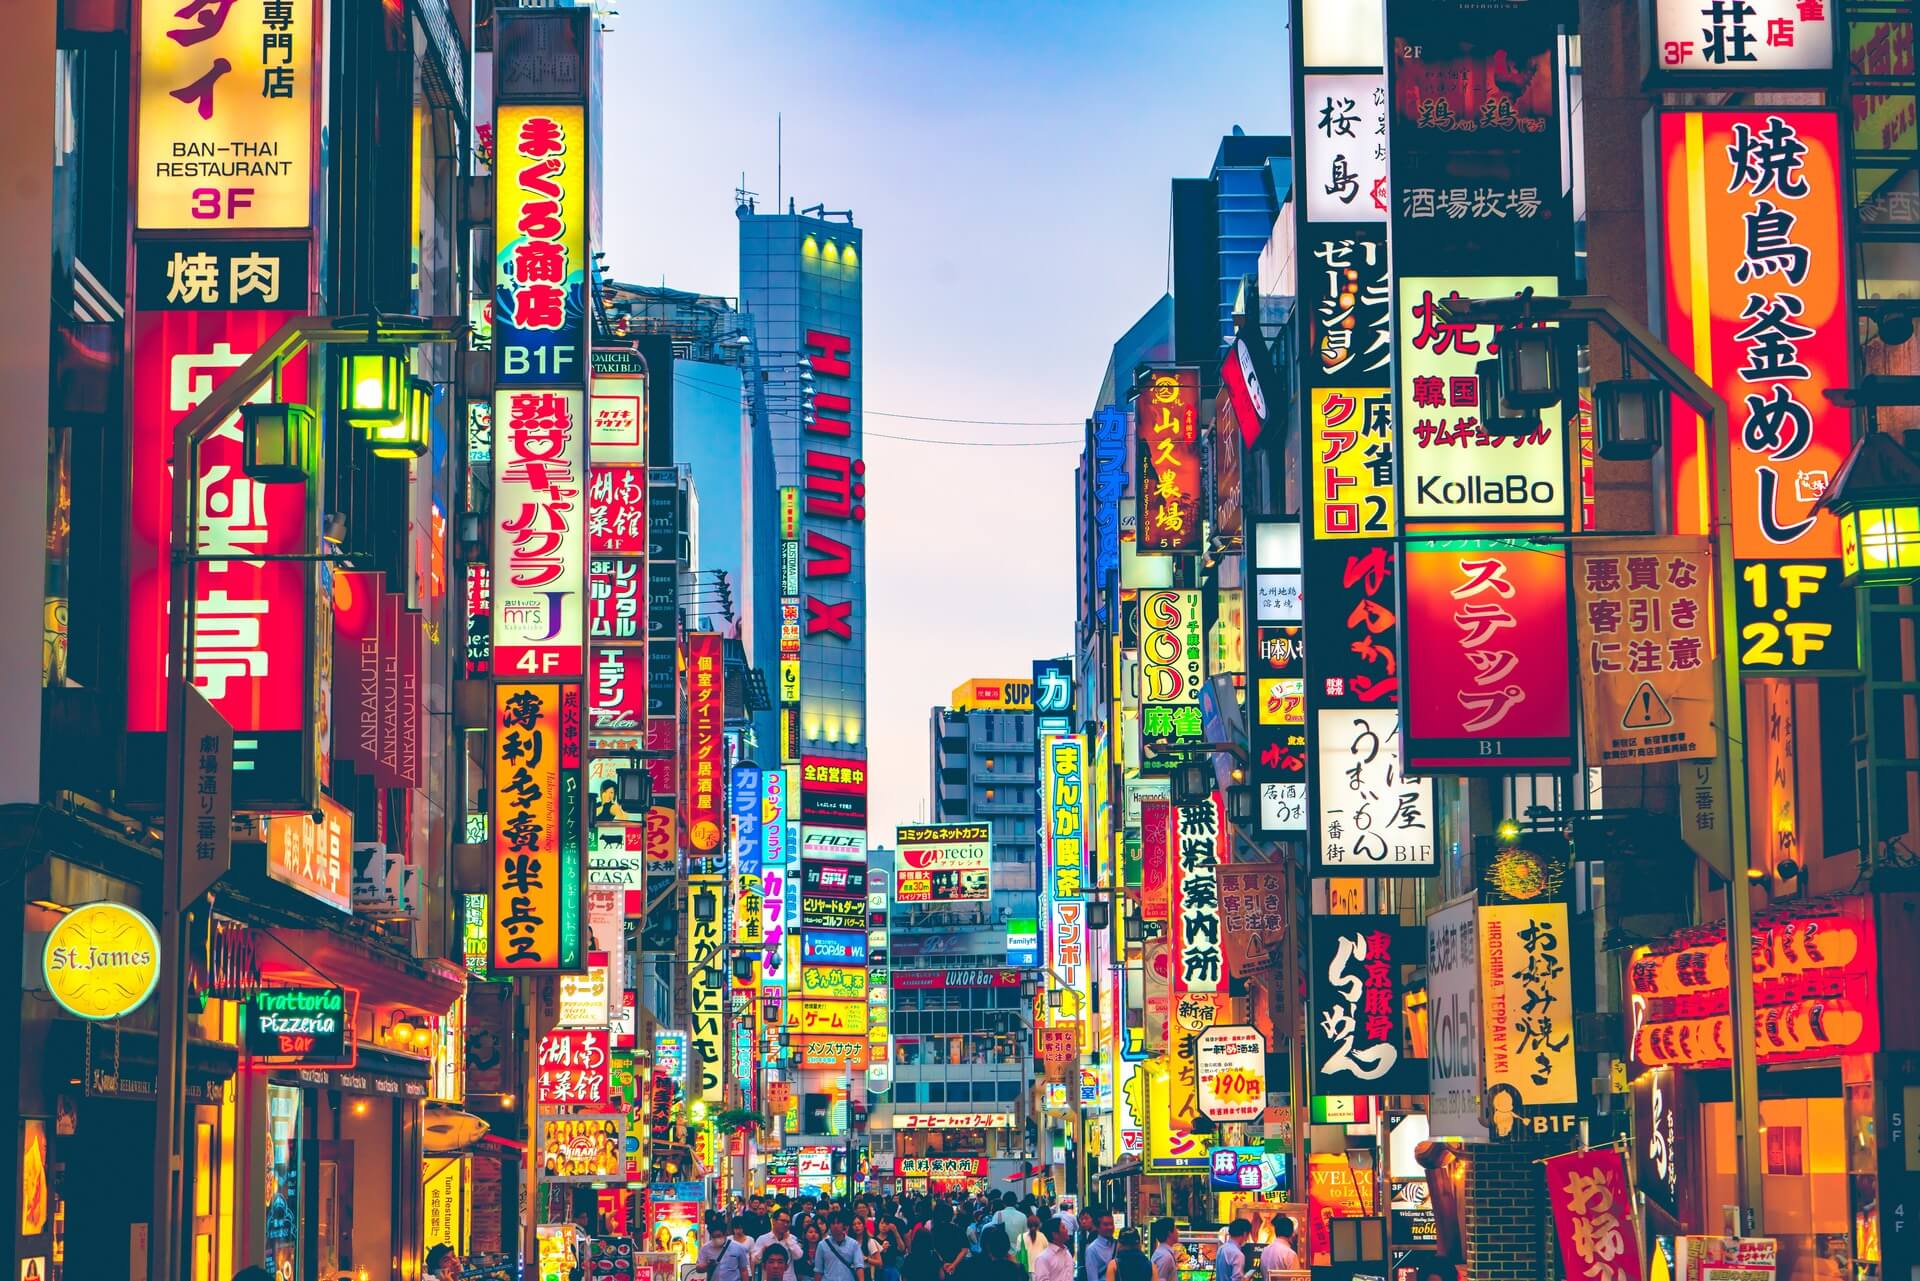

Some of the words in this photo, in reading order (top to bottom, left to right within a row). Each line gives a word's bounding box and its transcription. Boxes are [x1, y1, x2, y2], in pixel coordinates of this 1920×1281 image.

[1766, 17, 1795, 48] 店
[1404, 46, 1422, 58] 2F
[1664, 41, 1694, 65] 3F
[172, 141, 278, 157] BAN-THAI
[1317, 96, 1362, 204] 桜島
[156, 161, 292, 177] RESTAURANT
[191, 187, 255, 219] 3F
[1402, 187, 1543, 219] 酒場牧場
[514, 117, 568, 330] まぐろ商店
[166, 251, 280, 304] 焼肉
[1313, 239, 1357, 375] ゼーション
[1726, 116, 1817, 544] 焼鳥釜めし
[504, 346, 575, 375] B1F
[1412, 375, 1479, 408] 韓国
[1153, 407, 1185, 532] 山久農場
[1322, 393, 1359, 533] クアトロ
[501, 393, 579, 587] 熟女キャバクラ
[1416, 474, 1555, 505] KollaBo
[603, 538, 624, 549] 4F
[1159, 538, 1182, 548] 5F
[591, 560, 611, 574] 3F
[1584, 556, 1698, 593] 悪質な
[616, 560, 638, 637] レンタル
[1742, 563, 1827, 609] 1F
[590, 576, 612, 637] ルーム
[1587, 597, 1700, 634] 客引き
[1187, 594, 1200, 660] リーチ麻雀
[1143, 591, 1184, 701] GOD
[1450, 558, 1526, 732] ステップ
[1589, 637, 1703, 674] に注意
[1741, 622, 1832, 666] 2F
[515, 649, 560, 674] 4F
[360, 636, 378, 753] ANRAKUTEI
[599, 649, 625, 709] エデン
[1004, 683, 1033, 705] SUP
[380, 655, 397, 769] ANRAKUTEI
[1267, 696, 1304, 714] クア
[398, 672, 415, 781] ANRAKUTEI
[696, 656, 713, 810] 個室ダイニング居酒屋
[1143, 706, 1202, 737] 麻雀
[1479, 741, 1503, 755] B1
[804, 764, 864, 785] 全店営業中
[1345, 718, 1388, 861] うまいもん
[198, 735, 219, 861] 劇場通り一番街
[735, 769, 758, 857] カラオケ
[898, 828, 988, 841] コミック&ネットカフェ
[1054, 747, 1082, 899] まんが喫茶
[1327, 808, 1345, 863] 一番街
[804, 834, 865, 847] FACE
[1395, 845, 1431, 862] B1F
[1180, 802, 1218, 982] 無料案内所
[746, 895, 759, 938] 麻雀
[822, 915, 843, 928] ゴルフ
[1058, 903, 1082, 986] マンボー
[1488, 921, 1504, 988] HIROSHIMA
[804, 967, 865, 989] まんが喫茶
[945, 970, 976, 986] LUXOR
[977, 970, 993, 985] Bar
[1363, 929, 1394, 1041] 東京豚骨
[257, 991, 342, 1012] Trattoria
[1178, 1000, 1214, 1020] 新宿
[1511, 918, 1570, 1086] お好み焼き
[259, 1014, 335, 1034] Pizzeria
[279, 1035, 313, 1053] Bar
[807, 1042, 862, 1056] メンズサウナ
[1215, 1073, 1260, 1095] 190円
[906, 1115, 945, 1128] コーヒー
[973, 1115, 994, 1127] クール
[1532, 1115, 1576, 1134] B1F
[902, 1159, 972, 1172] 無料案内所
[1330, 1186, 1342, 1198] to
[1391, 1183, 1402, 1191] 3F
